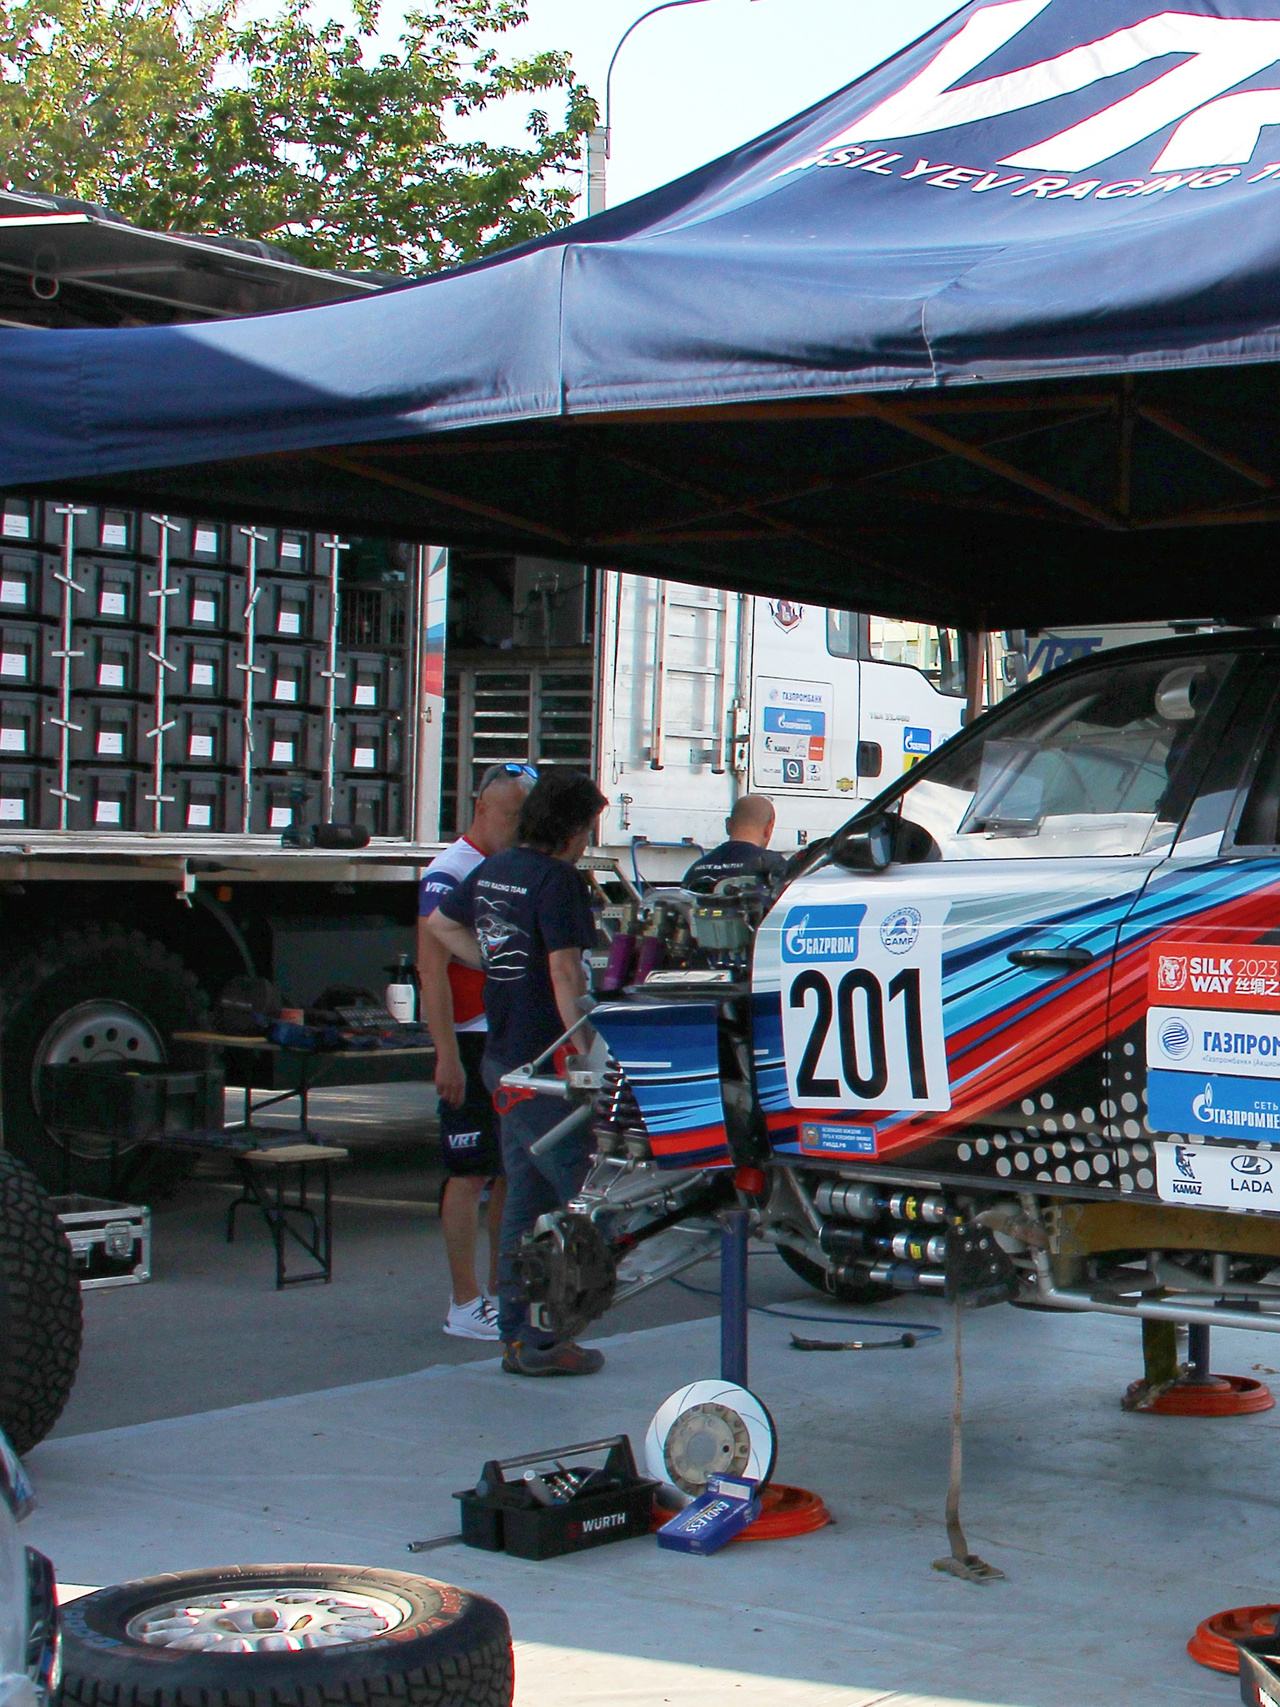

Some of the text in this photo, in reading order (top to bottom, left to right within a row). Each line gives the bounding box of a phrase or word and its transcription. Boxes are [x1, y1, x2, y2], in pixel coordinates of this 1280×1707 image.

[1011, 167, 1241, 200] RACING
[805, 936, 854, 955] GAZPROM
[885, 937, 913, 946] CAMF
[1190, 957, 1233, 976] SILK
[1237, 958, 1277, 978] 2023
[1190, 975, 1233, 993] WAY
[789, 967, 929, 1100] 201
[1254, 1101, 1279, 1111] СЕТЬ
[448, 1131, 481, 1148] VRT
[1173, 1183, 1202, 1196] KAMAZ
[1231, 1179, 1274, 1194] LADA
[582, 1512, 626, 1532] WÜRTH
[686, 1500, 730, 1534] ENDLESS
